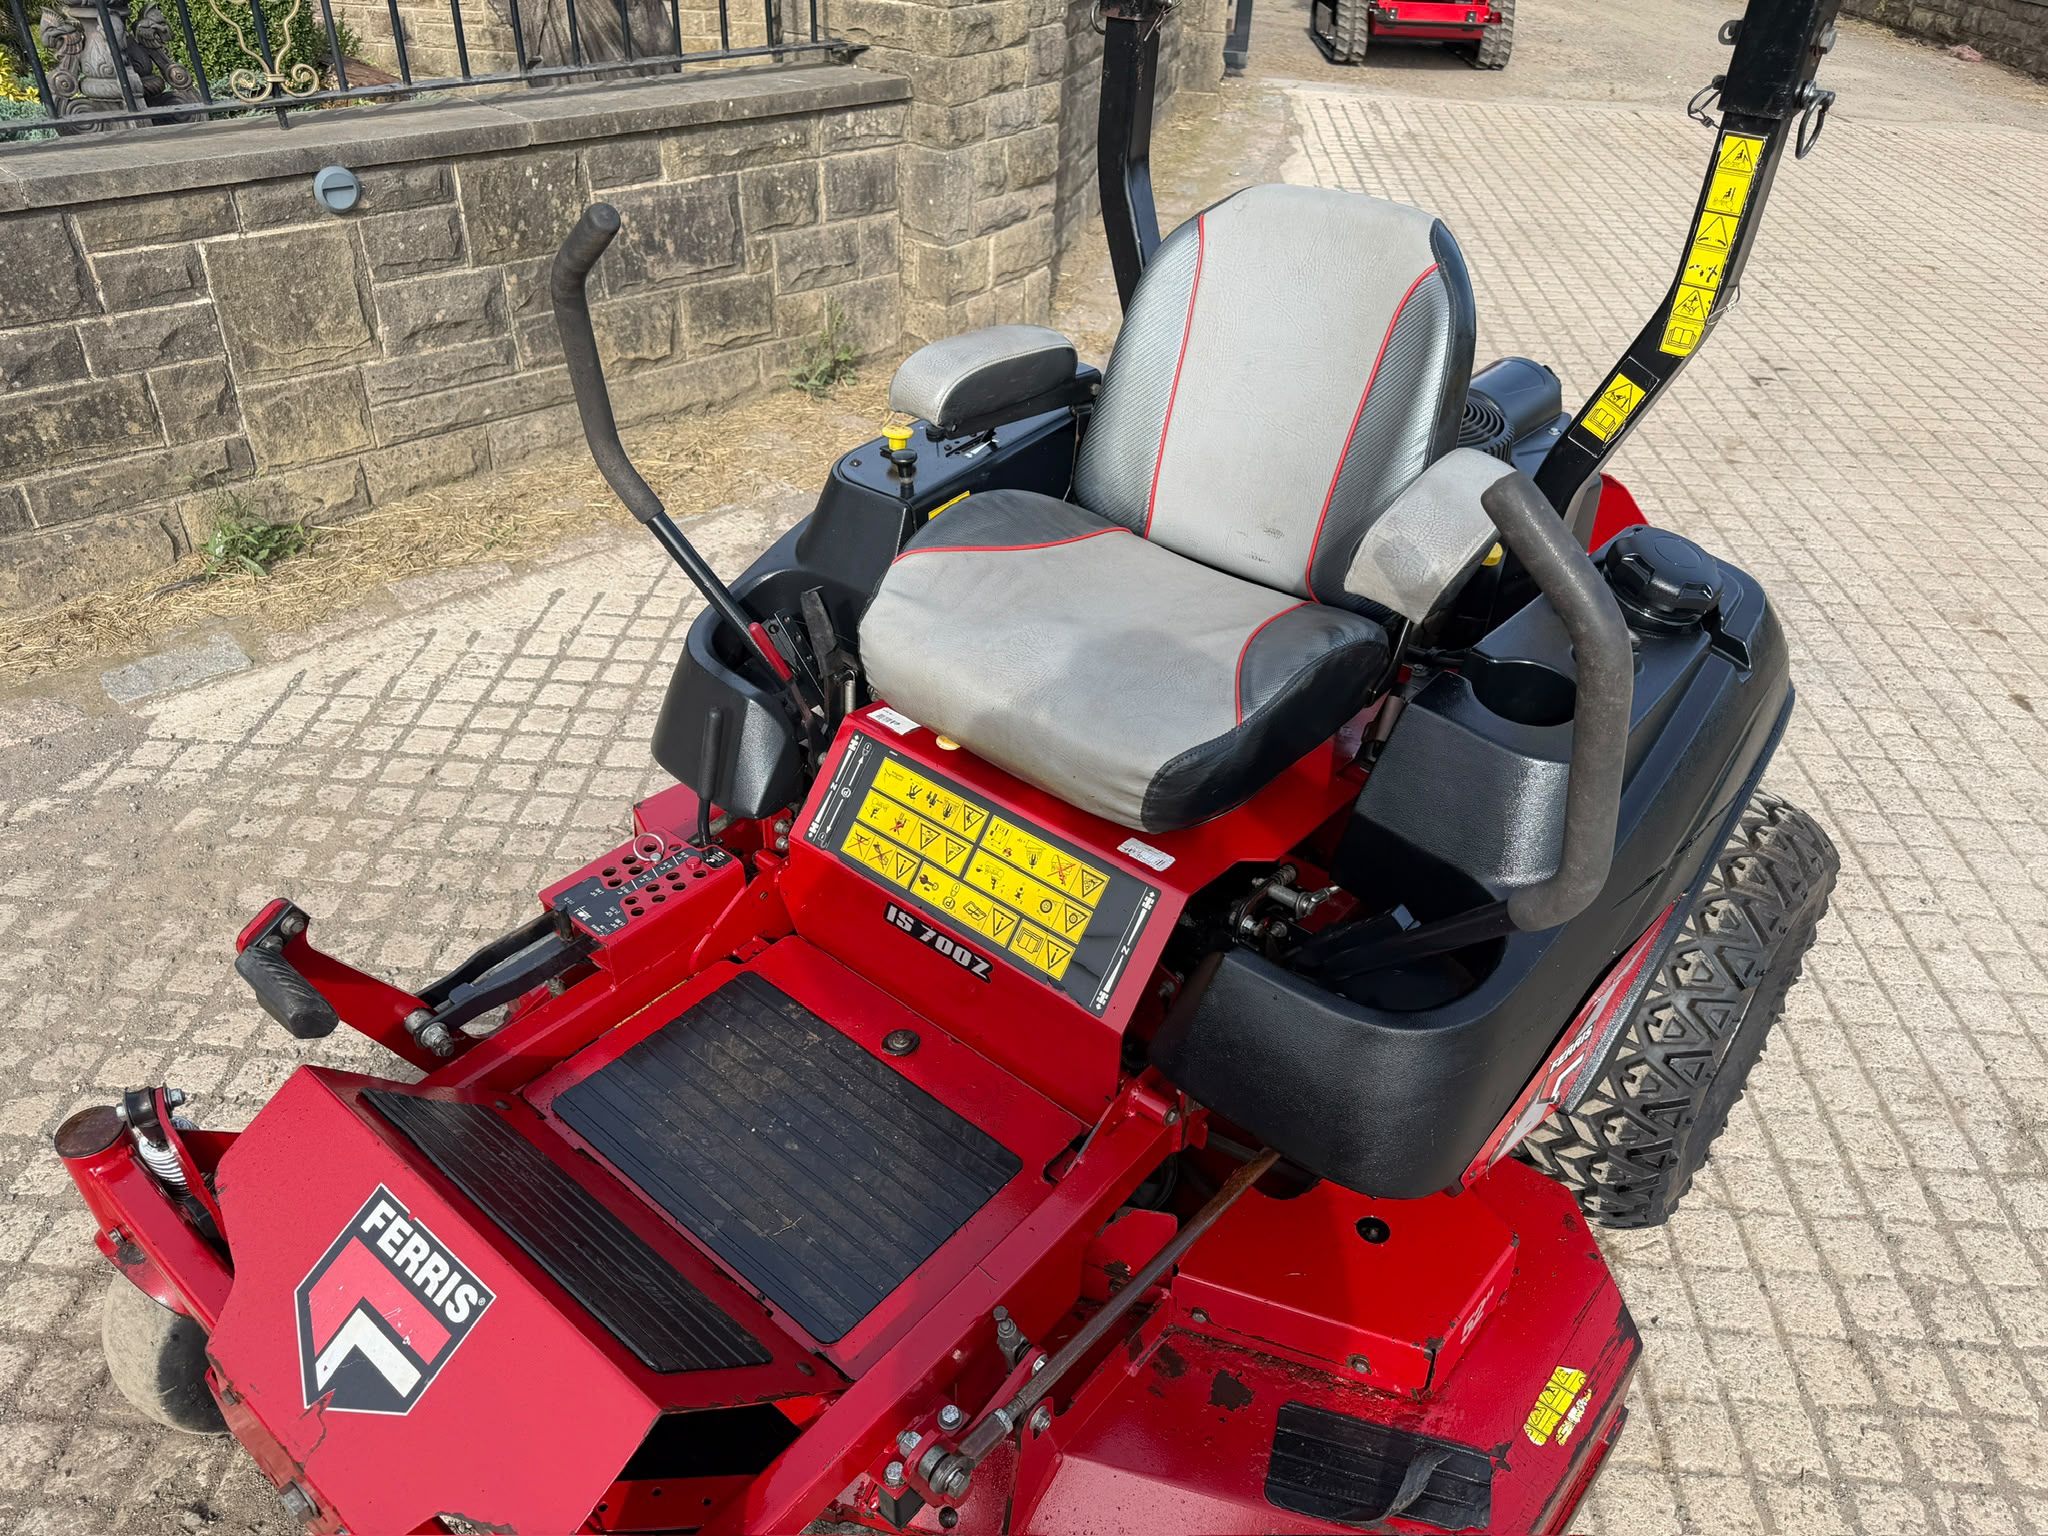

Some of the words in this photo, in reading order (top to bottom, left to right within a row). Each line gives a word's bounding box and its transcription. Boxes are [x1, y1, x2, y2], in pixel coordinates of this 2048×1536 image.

[886, 905, 914, 932] IS
[920, 923, 990, 980] 700Z
[1550, 1025, 1594, 1073] FERRIS
[361, 1200, 479, 1323] FERRIS
